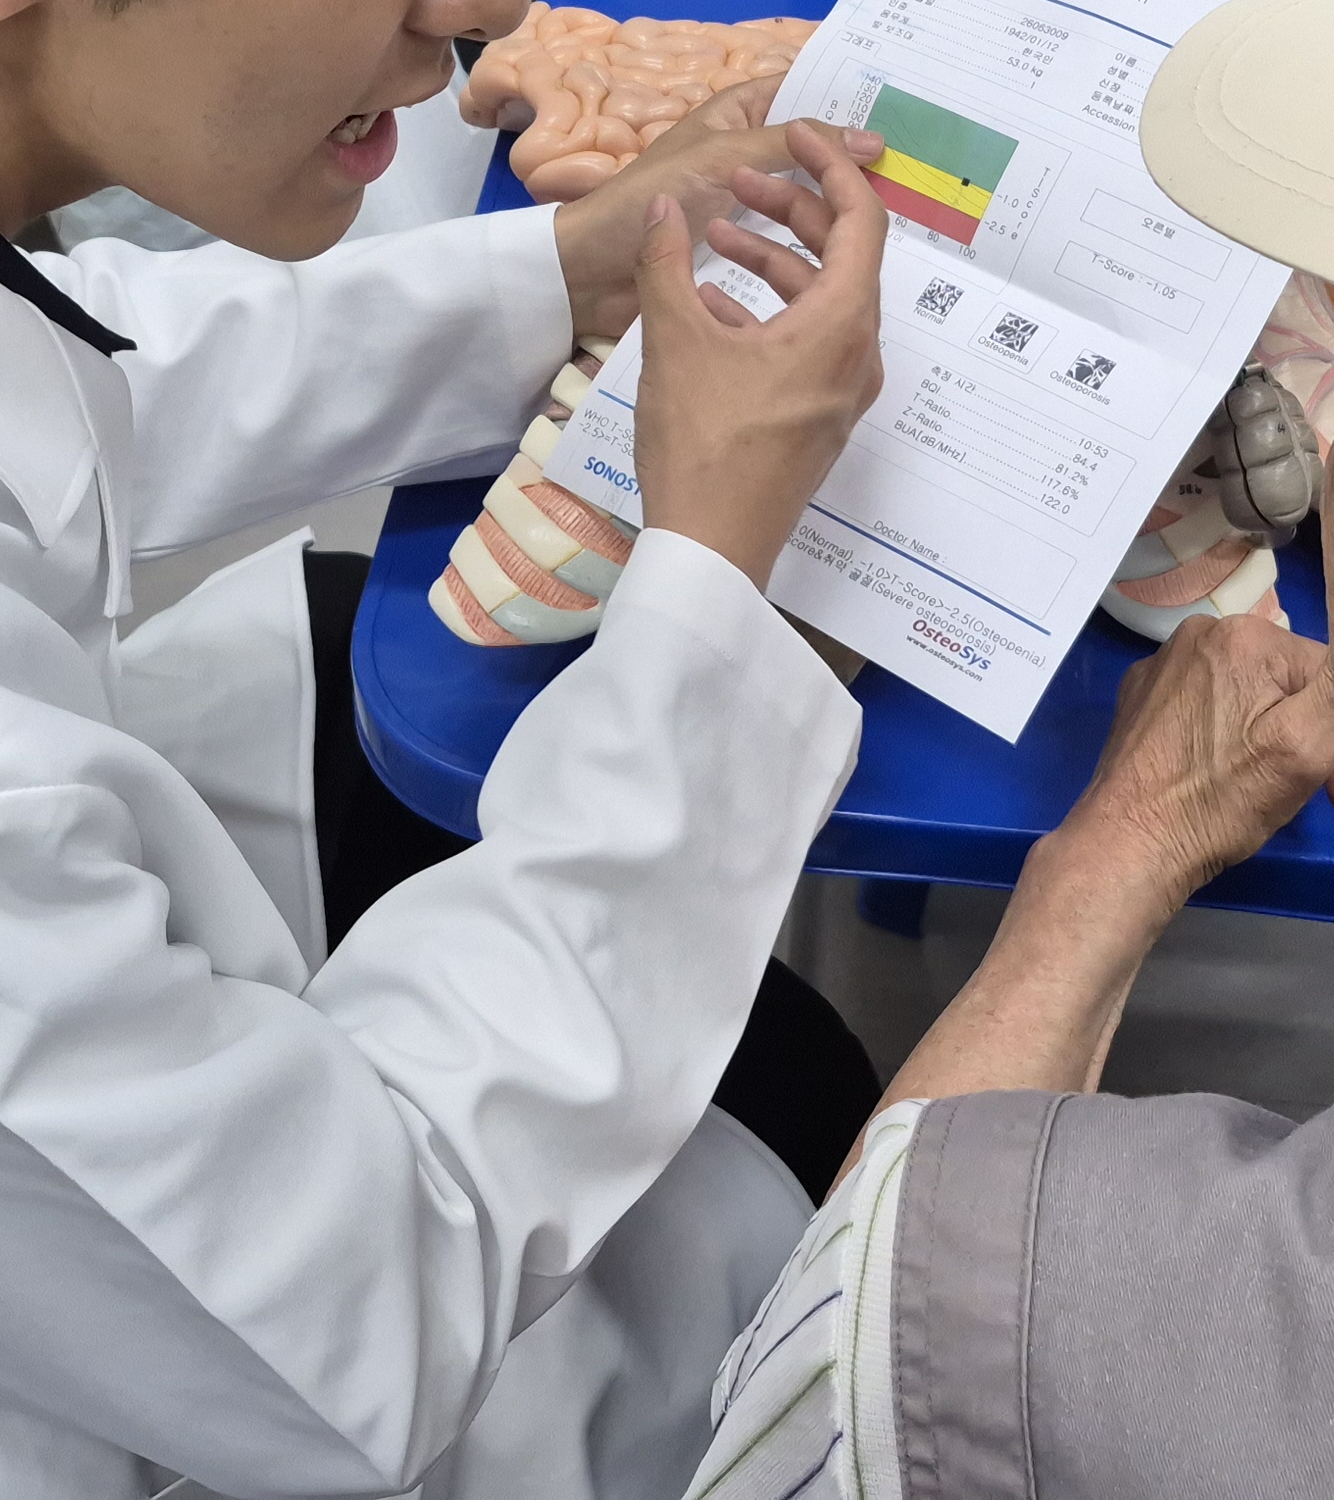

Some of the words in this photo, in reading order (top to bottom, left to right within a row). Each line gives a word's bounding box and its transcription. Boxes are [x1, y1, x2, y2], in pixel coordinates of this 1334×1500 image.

[885, 24, 915, 41] 보조대
[1003, 25, 1060, 53] 1942/01/12
[1020, 16, 1070, 41] 26063009
[840, 31, 877, 51] 그래프
[1006, 56, 1030, 71] 53.0
[1030, 65, 1045, 78] kg
[1021, 47, 1054, 66] 한국인
[1115, 51, 1138, 68] 이름
[864, 73, 882, 86] 140
[1107, 65, 1130, 81] 성별
[854, 90, 873, 104] 120
[859, 81, 877, 95] 130
[1099, 78, 1121, 93] 신장
[850, 100, 869, 114] 110
[1091, 90, 1135, 116] 등록날짜
[847, 109, 865, 123] 100
[1081, 104, 1136, 133] Accession
[997, 193, 1019, 209] -1.0
[894, 215, 908, 229] 60
[984, 220, 1006, 236] -2.5
[1140, 216, 1176, 240] 오른발
[926, 230, 940, 243] 80
[958, 245, 977, 260] 100
[1090, 252, 1136, 282] T-Score
[1145, 280, 1177, 301] -1.05
[912, 306, 947, 326] Normal
[977, 335, 1030, 367] Osteopenia
[920, 378, 941, 396] BQI
[930, 365, 953, 383] 측정
[954, 378, 977, 395] 시간
[1049, 370, 1112, 407] Osteoporosis
[912, 392, 952, 419] T-Ratio
[584, 408, 610, 428] WHO
[610, 421, 636, 442] T-Sc
[902, 405, 943, 433] Z-Ratio
[893, 419, 968, 463] BUA[dB/MHz]
[1077, 436, 1110, 460] 10:53
[1071, 453, 1099, 473] 84.4
[1054, 463, 1091, 487] 81.2%
[1039, 474, 1081, 501] 117.6%
[1039, 493, 1072, 516] 122.0
[578, 421, 635, 457] -2.5>=T-Sc
[916, 606, 997, 657] osteoporosis)
[872, 519, 909, 550] Doctor
[909, 539, 941, 563] Name
[912, 618, 992, 671] OsteoSys
[905, 634, 984, 682] www.osteosys.com
